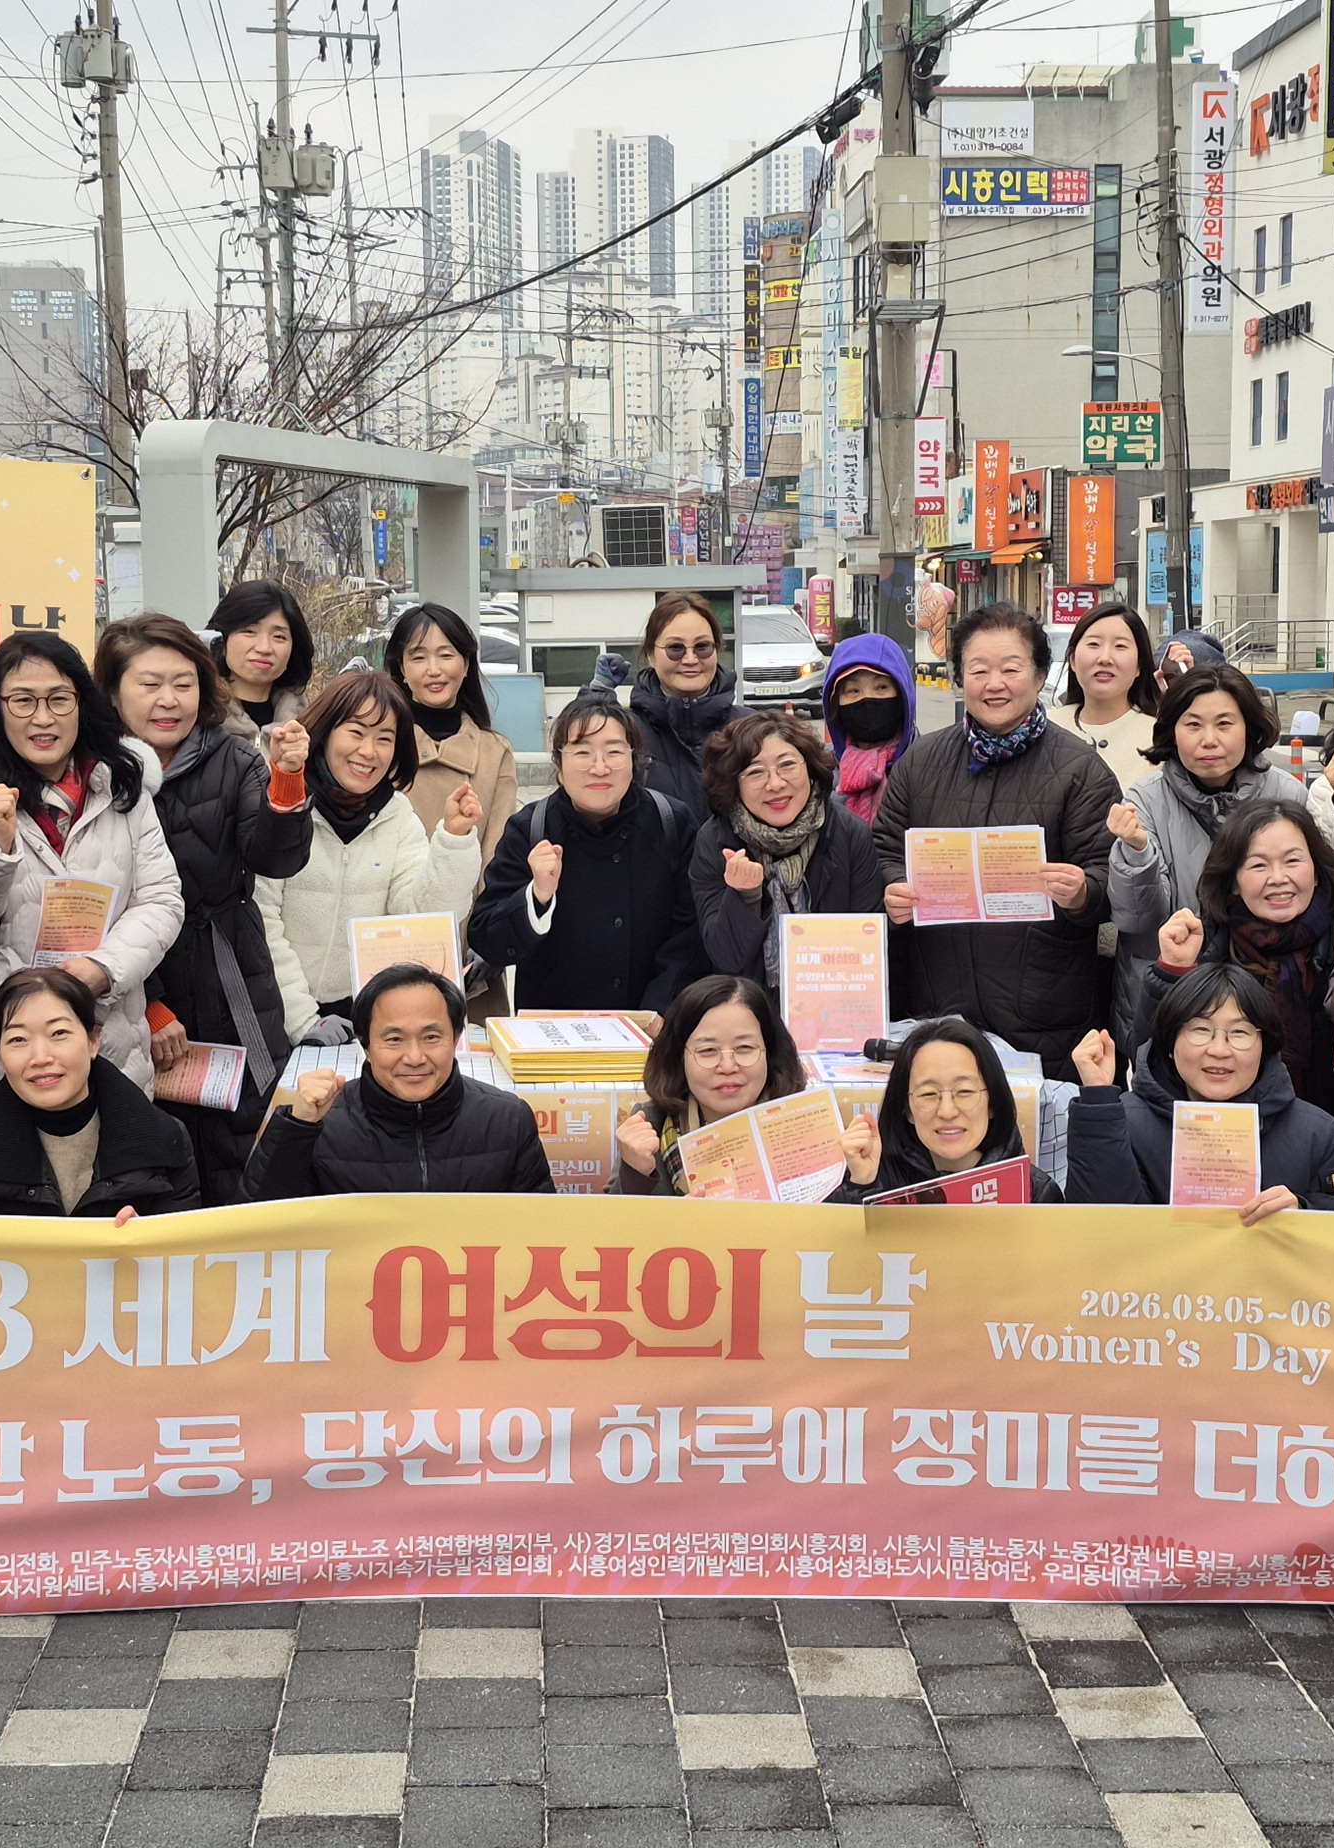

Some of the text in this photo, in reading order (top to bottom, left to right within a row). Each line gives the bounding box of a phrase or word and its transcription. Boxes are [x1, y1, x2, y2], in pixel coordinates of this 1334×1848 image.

[945, 168, 1049, 203] 시흥인력
[746, 229, 759, 258] 치과
[745, 269, 760, 349] 교통사고
[1088, 415, 1155, 433] 지리산
[918, 439, 941, 489] 약국
[1085, 435, 1157, 461] 약국
[815, 594, 832, 628] 보청기
[1056, 591, 1095, 612] 약국
[565, 1111, 593, 1135] 날
[549, 1160, 601, 1177] 당신의
[62, 1246, 333, 1370] 세계
[364, 1244, 766, 1364] 여성의
[796, 1248, 928, 1361] 날
[1079, 1289, 1332, 1329] 2026.03.05~06
[984, 1320, 1332, 1386] Women's Day
[56, 1412, 275, 1507] 노동,
[300, 1405, 575, 1491] 당신의
[595, 1403, 868, 1487] 하루에
[891, 1408, 1165, 1497] 장미를
[70, 1543, 262, 1573] 민주노동자시흥연대,
[268, 1537, 391, 1563] 보건의료노조
[883, 1535, 942, 1558] 시흥시
[946, 1535, 1046, 1561] 돌봄노동자
[1050, 1540, 1150, 1565] 노동건강권
[1154, 1547, 1242, 1573] 네트워크,
[117, 1564, 309, 1594] 시흥시주거복지센터,
[568, 1553, 770, 1578] 시흥여성인력개발센터,
[775, 1554, 1035, 1583] 시흥여성친화도시시민참여단,
[1043, 1561, 1188, 1590] 우리동네연구소,
